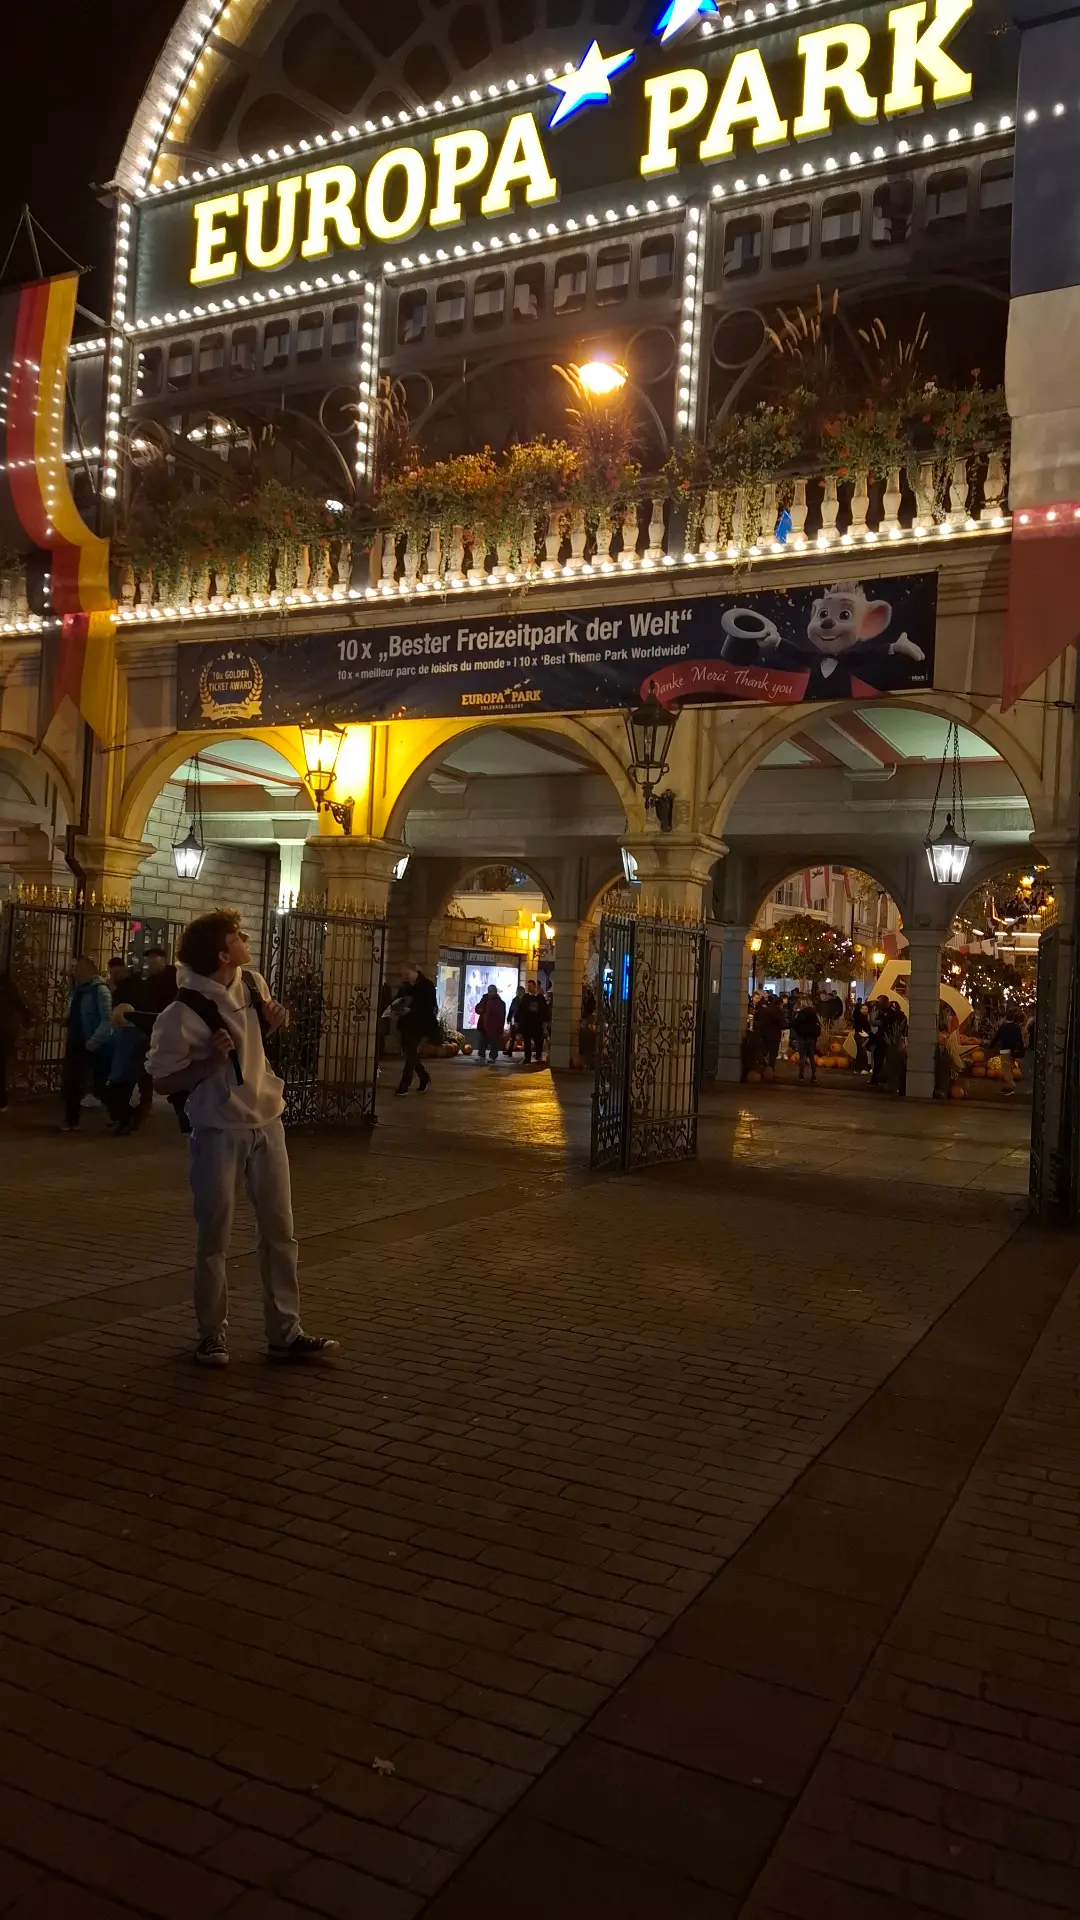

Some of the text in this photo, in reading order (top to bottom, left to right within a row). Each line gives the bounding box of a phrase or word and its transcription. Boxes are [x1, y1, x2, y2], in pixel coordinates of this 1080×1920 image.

[190, 0, 973, 286] EUROPA PARK
[338, 609, 693, 662] 10 x „Bester Freizeitpark der Welt“
[224, 669, 250, 679] GOLDEN
[396, 666, 417, 678] parc
[418, 664, 429, 675] de
[431, 662, 458, 674] loisirs
[460, 661, 472, 672] du
[520, 656, 531, 667] 10
[568, 651, 602, 664] Theme
[604, 648, 628, 661] Park
[209, 680, 253, 692] TICKET AWARD
[691, 666, 729, 682] Merci
[734, 669, 769, 691] Thank
[768, 682, 793, 699] you
[461, 690, 542, 706] EUROPA PARK
